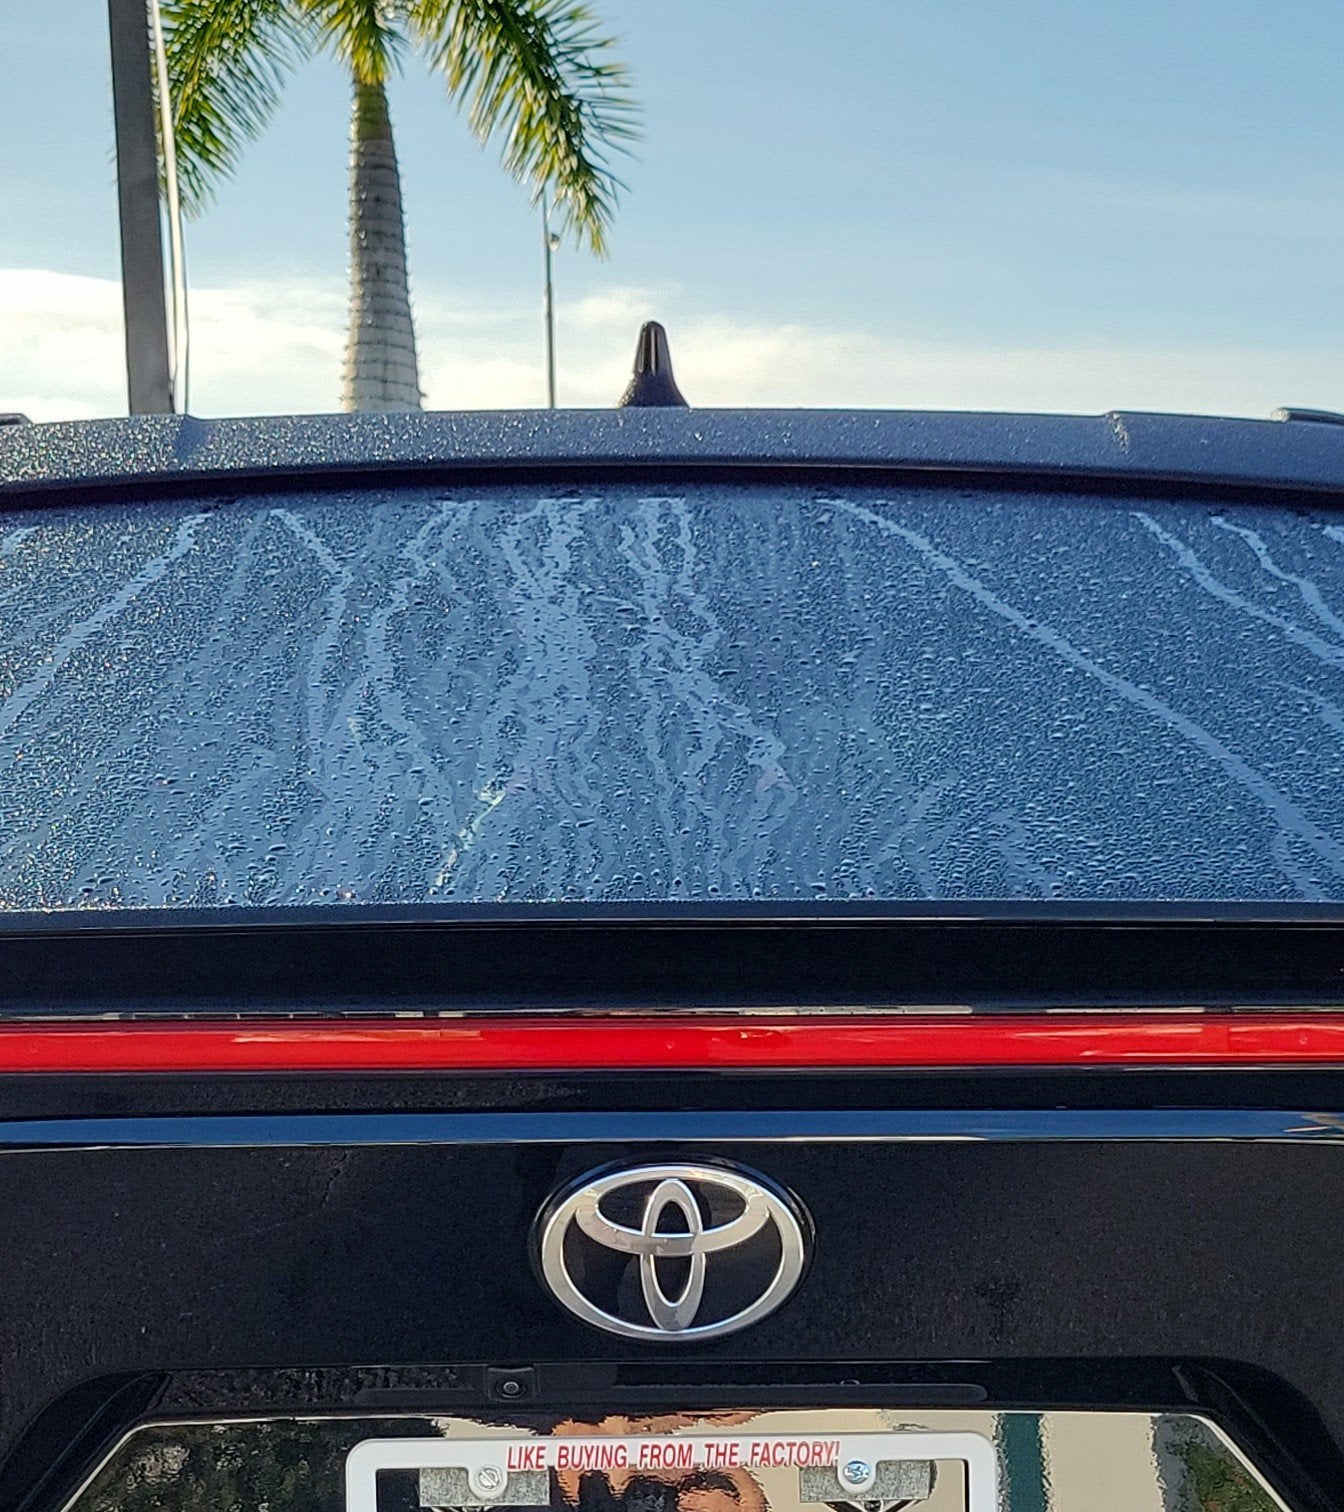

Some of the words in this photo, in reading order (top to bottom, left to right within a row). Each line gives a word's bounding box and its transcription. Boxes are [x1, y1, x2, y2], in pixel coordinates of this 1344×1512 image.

[506, 1445, 546, 1470] LIKE
[557, 1443, 628, 1469] BUYING
[638, 1442, 694, 1469] FROM
[704, 1442, 740, 1467] THE
[750, 1440, 840, 1467] FACTORY!
